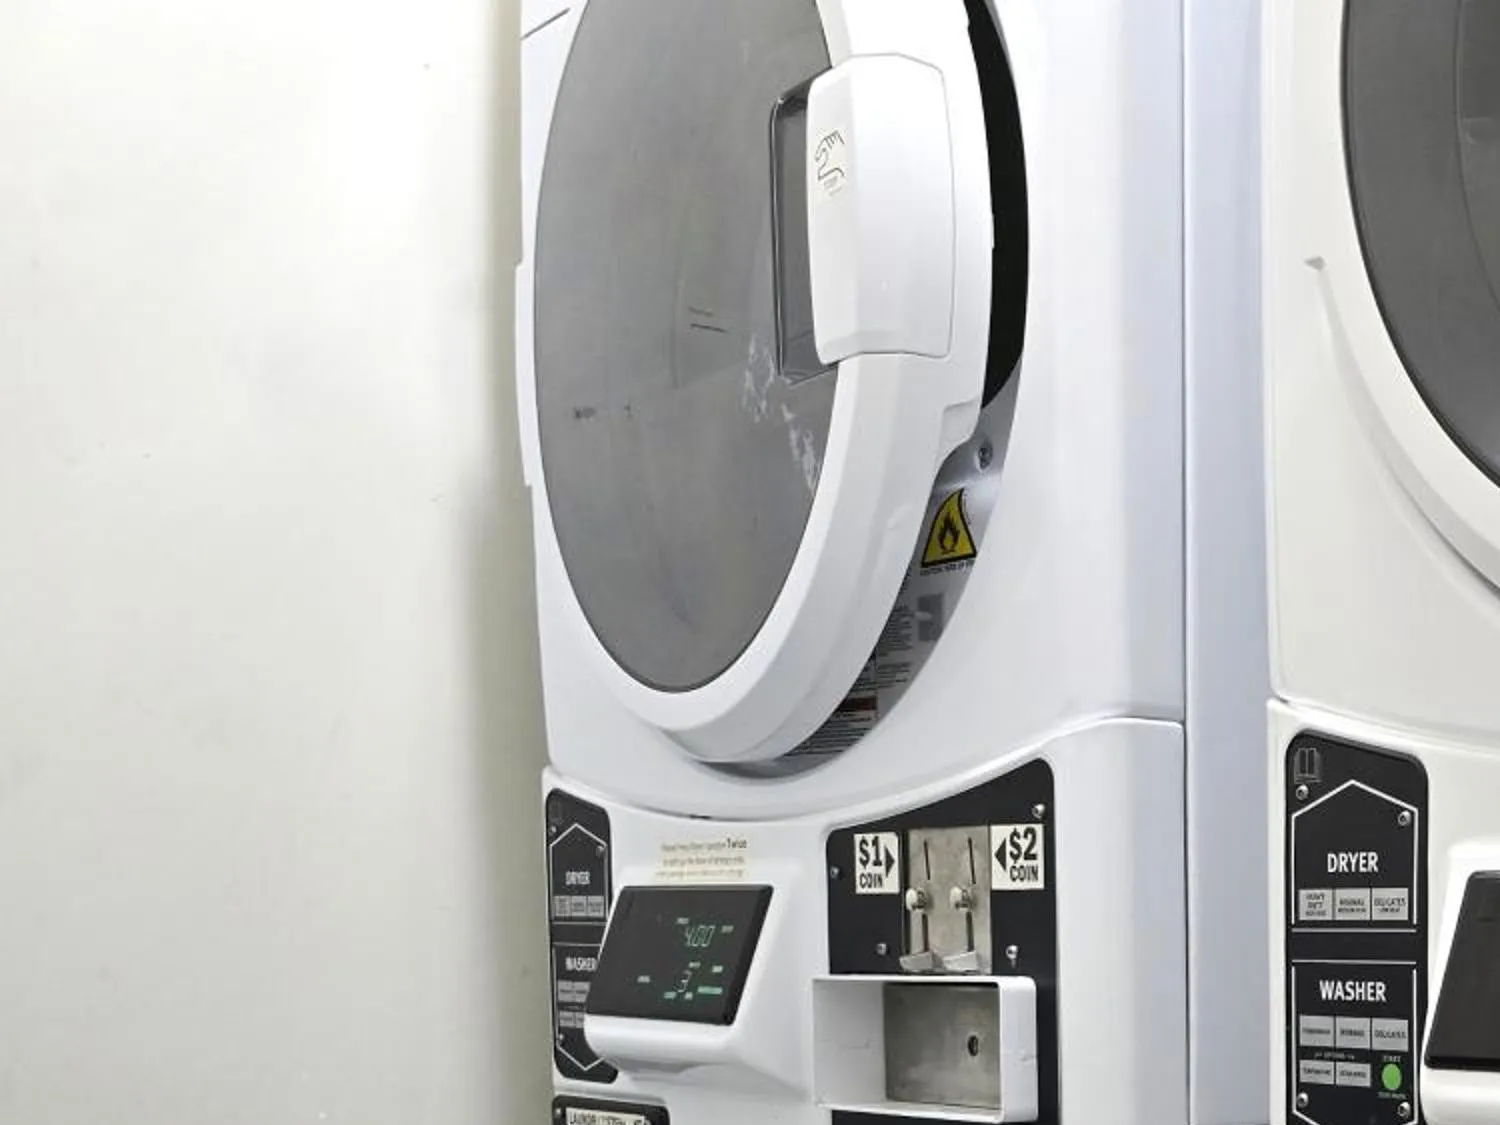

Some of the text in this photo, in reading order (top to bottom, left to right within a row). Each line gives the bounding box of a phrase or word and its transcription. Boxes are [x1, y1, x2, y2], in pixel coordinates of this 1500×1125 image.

[859, 835, 884, 869] $1
[1009, 826, 1038, 864] $2
[1327, 851, 1379, 873] DRYER
[859, 871, 884, 890] COIN
[1009, 865, 1039, 883] COIN
[1319, 979, 1388, 1002] WASHER
